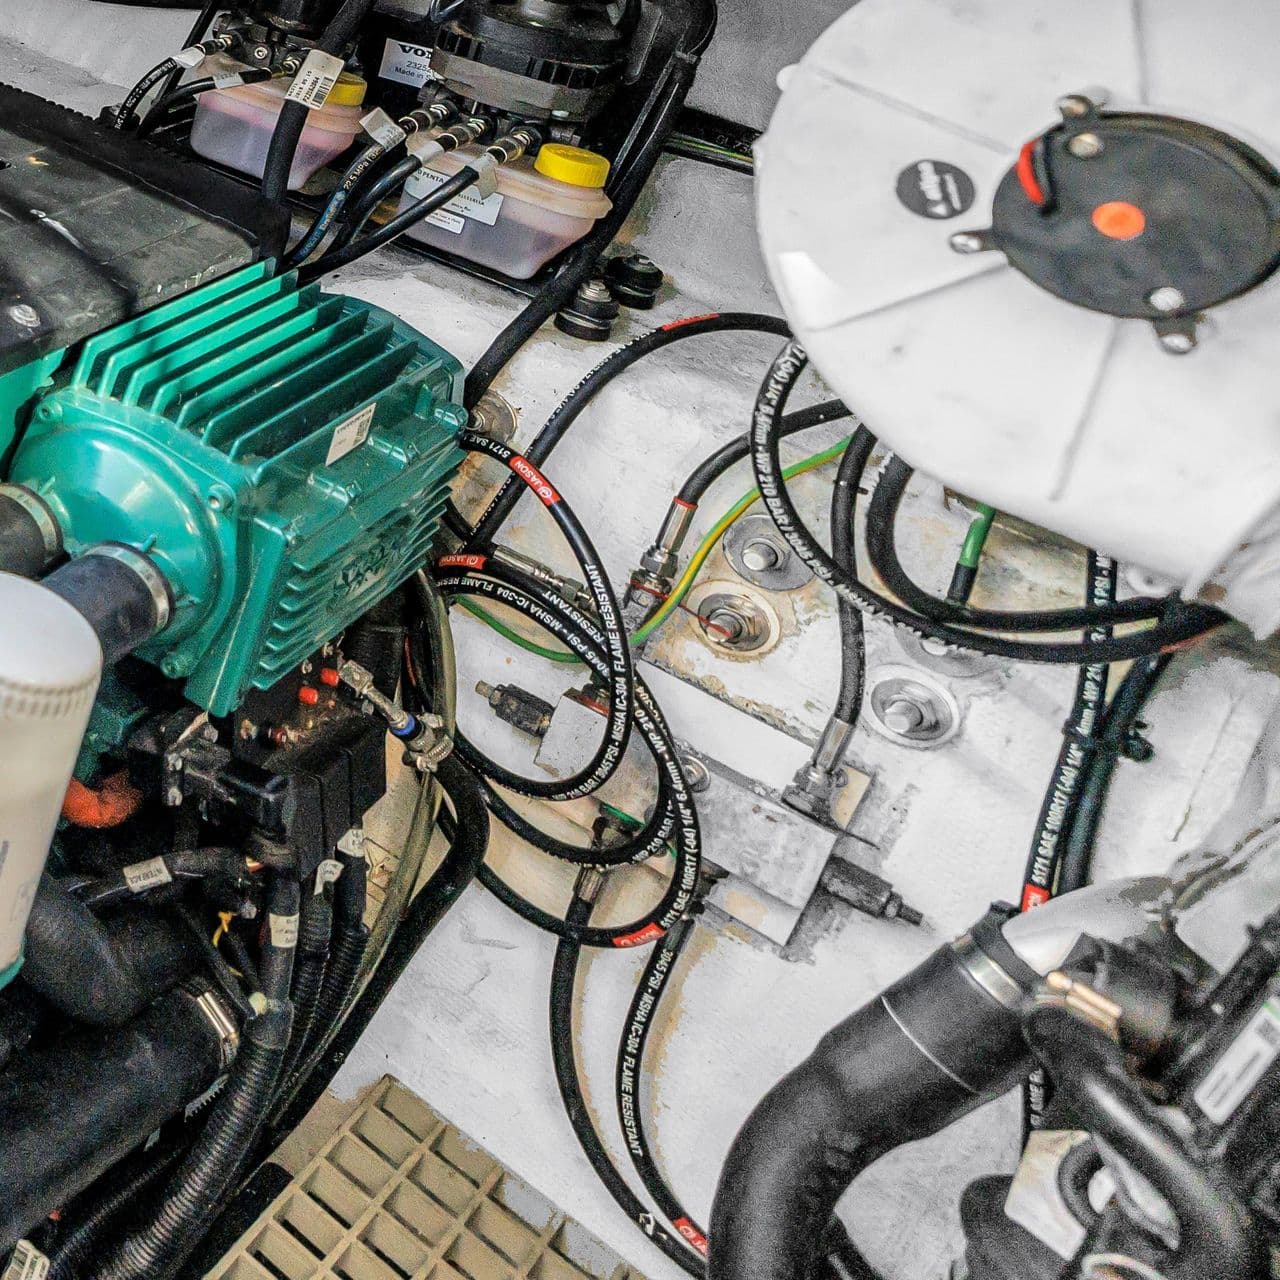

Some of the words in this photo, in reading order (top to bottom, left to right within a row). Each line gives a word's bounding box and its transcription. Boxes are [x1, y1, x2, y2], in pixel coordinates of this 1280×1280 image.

[395, 66, 416, 78] Made
[469, 434, 489, 447] SAE
[488, 441, 511, 459] 5171
[514, 460, 544, 487] JASON
[460, 576, 494, 592] FLAME
[584, 563, 619, 629] RESISTANT
[528, 601, 564, 632] MSHA
[541, 590, 606, 643] RESISTANT
[566, 632, 589, 656] PSI
[608, 630, 627, 673] FLAME
[611, 710, 627, 742] MSHA
[673, 889, 690, 911] SAE
[660, 907, 681, 929] 5171
[647, 970, 663, 991] PSI
[635, 994, 654, 1022] MSHA
[621, 1055, 636, 1093] FLAME
[621, 1092, 643, 1157] RESISTANT
